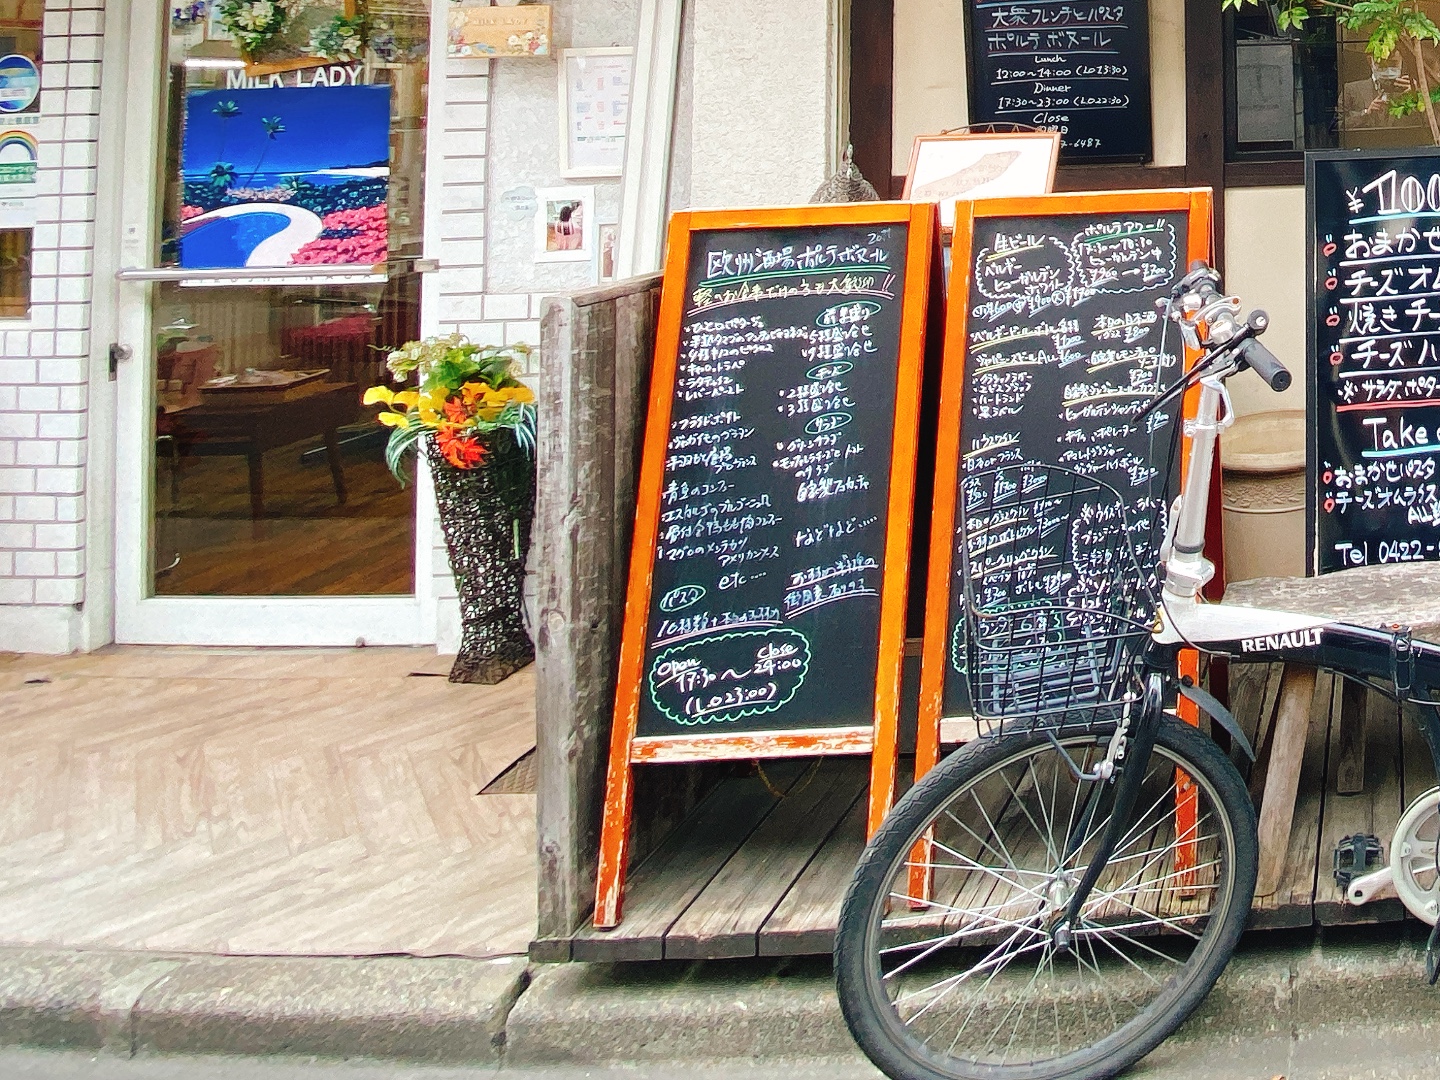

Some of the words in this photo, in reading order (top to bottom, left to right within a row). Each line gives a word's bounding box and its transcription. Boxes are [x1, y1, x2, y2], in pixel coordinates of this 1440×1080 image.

[1034, 55, 1067, 63] Lunch
[297, 65, 363, 87] LADY
[1033, 83, 1071, 94] Dinner
[1033, 112, 1070, 124] Close
[1362, 416, 1428, 451] Take
[1335, 541, 1368, 566] Tel
[1240, 627, 1325, 653] RENAULT
